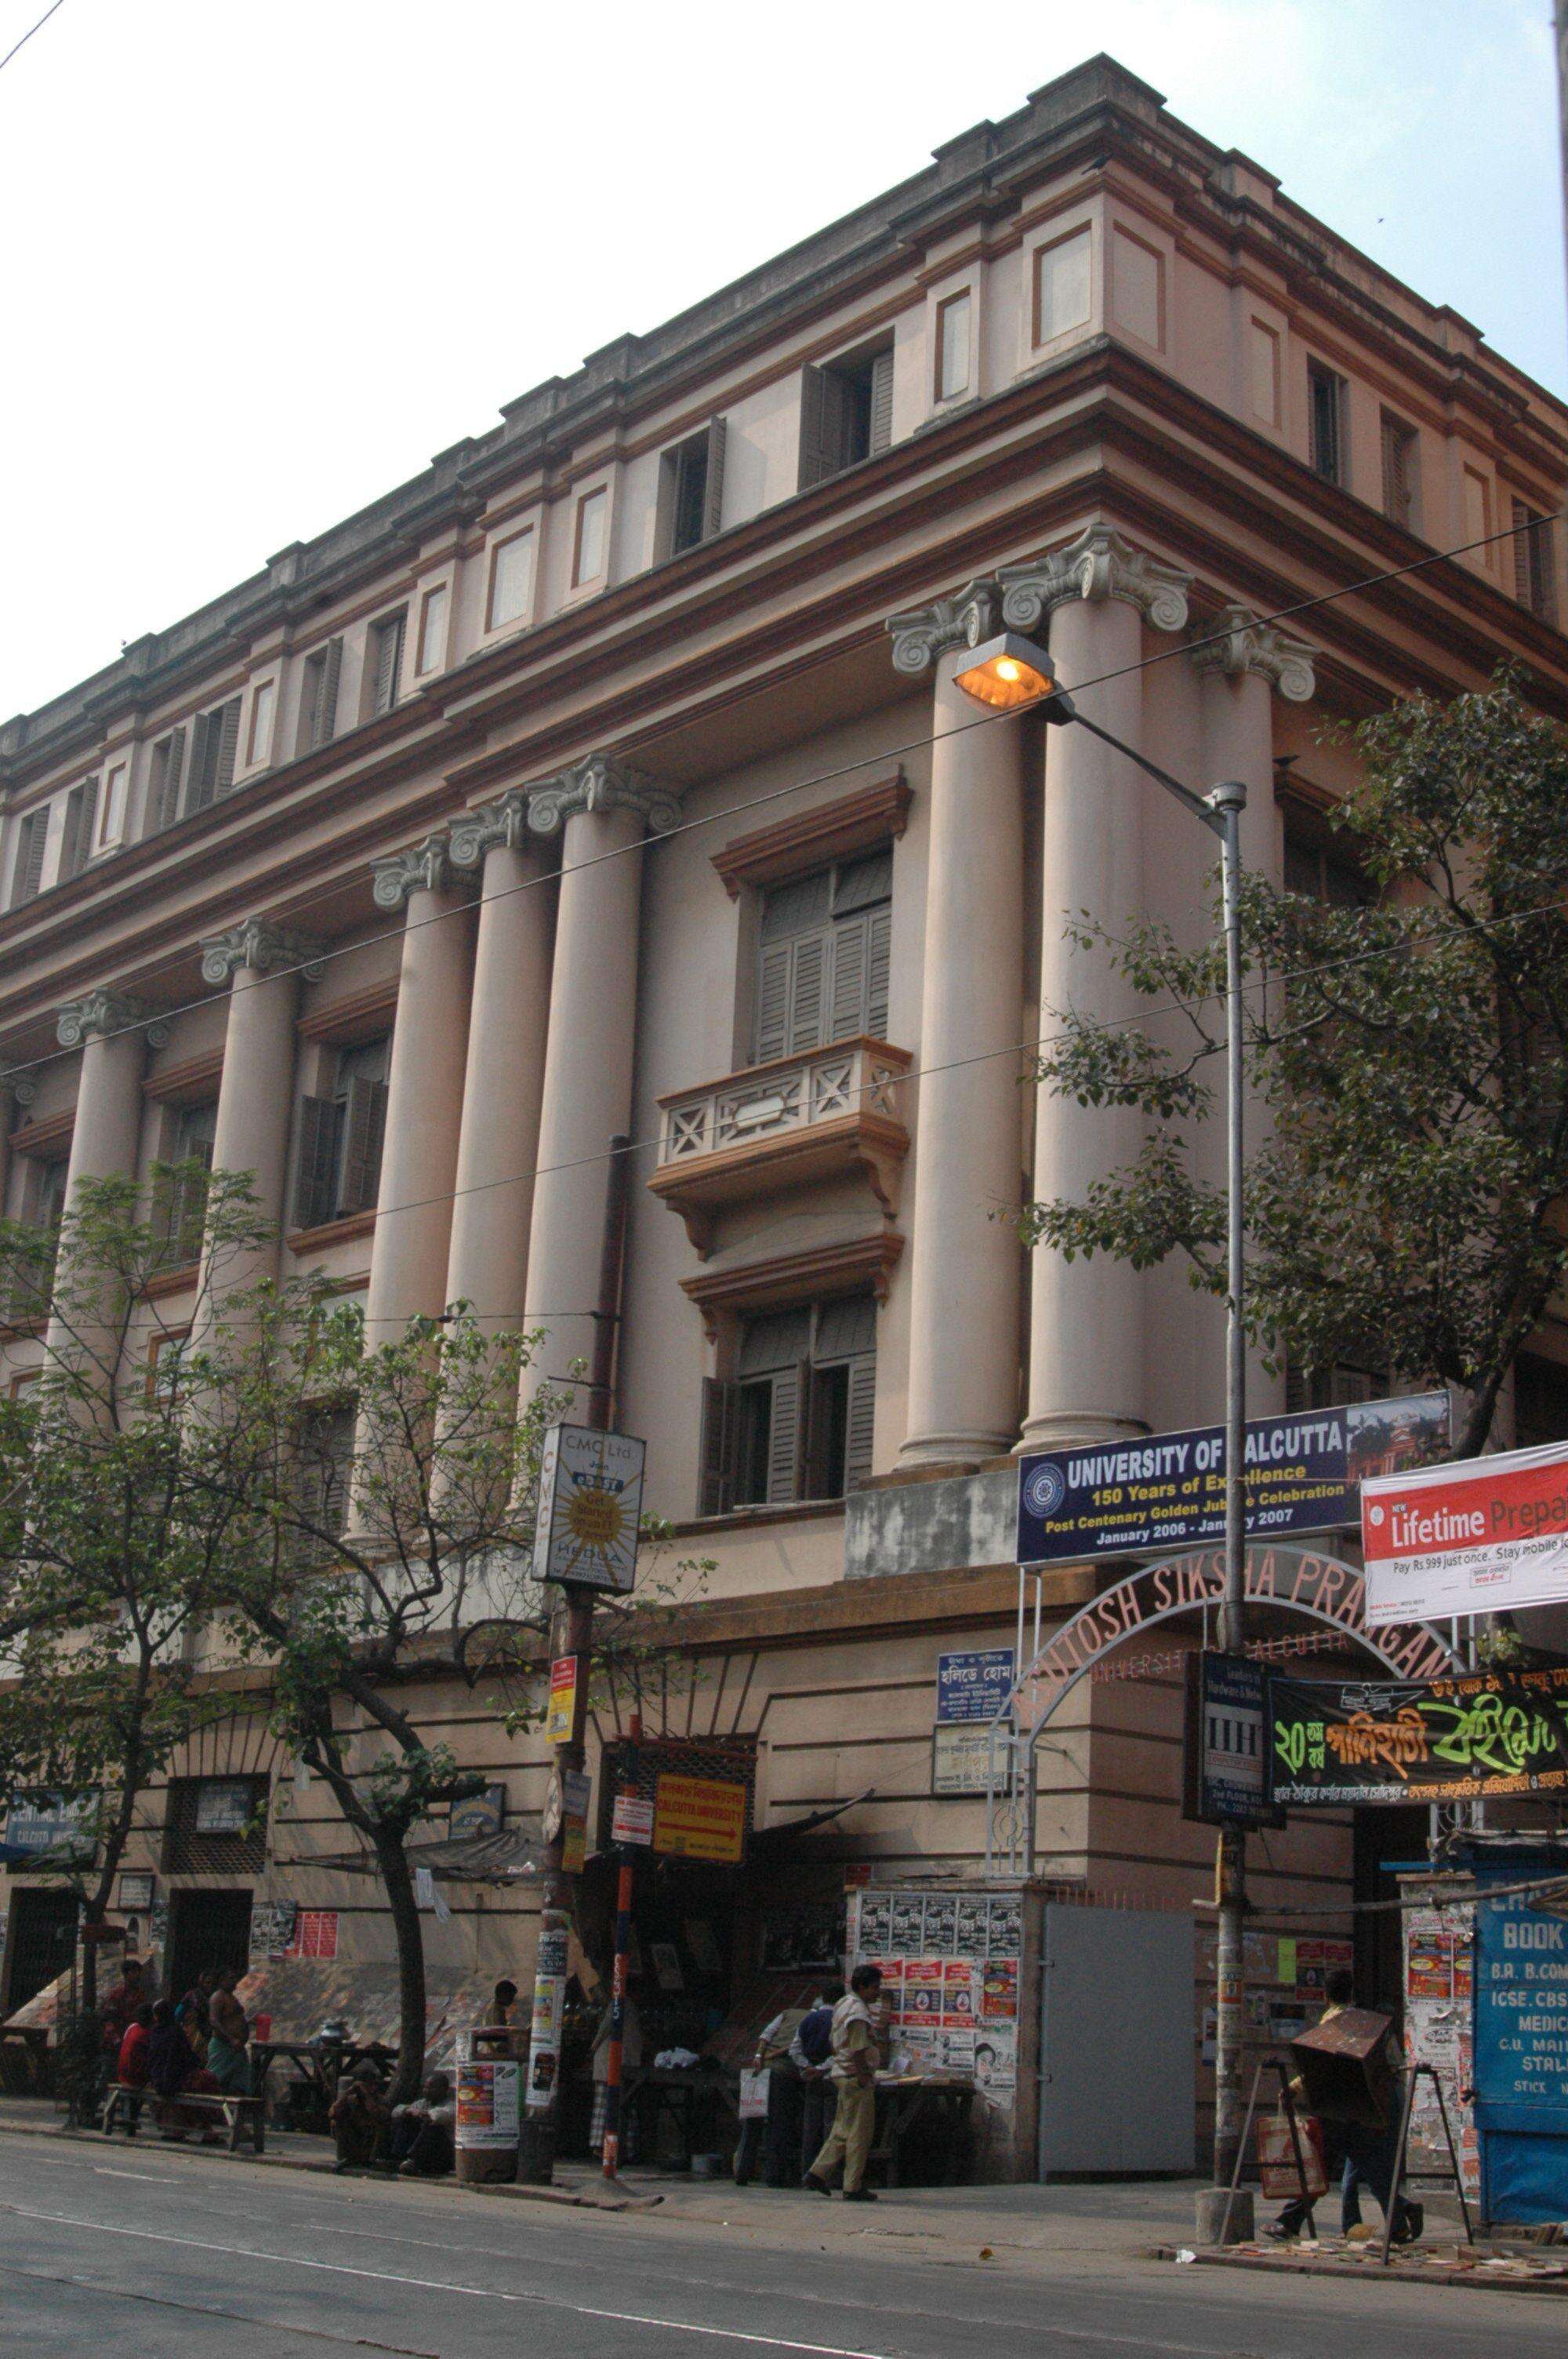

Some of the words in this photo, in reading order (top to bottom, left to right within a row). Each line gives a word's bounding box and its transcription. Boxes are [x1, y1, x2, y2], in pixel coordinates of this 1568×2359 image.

[1068, 1444, 1190, 1488] UNIVERSITY
[1195, 1438, 1223, 1471] OF
[1244, 1421, 1343, 1463] ALCUTTA
[1092, 1488, 1122, 1506] 150
[1127, 1483, 1175, 1502] Years
[1181, 1477, 1200, 1494] of
[1206, 1465, 1307, 1491] Exllence
[1046, 1520, 1074, 1533] Post
[1078, 1511, 1146, 1529] Centenary
[1150, 1503, 1199, 1520] Golden
[1203, 1496, 1254, 1514] Jube
[1259, 1484, 1345, 1506] Celebration
[1096, 1530, 1150, 1545] January
[1153, 1522, 1186, 1539] 2006
[1199, 1516, 1254, 1532] Jany
[1258, 1508, 1294, 1525] 2007
[1392, 1507, 1486, 1548] Lifetime
[1490, 1494, 1568, 1536] Prepa
[1393, 1561, 1410, 1575] Pay
[1443, 1554, 1462, 1570] just
[1496, 1547, 1521, 1561] Stay
[1523, 1539, 1558, 1555] mobile
[941, 1665, 978, 1686] হলিডে
[983, 1665, 1011, 1683] হোম
[1088, 1648, 1185, 1685] UNIVERSIT
[1504, 1923, 1564, 1950] BOOK
[1522, 2056, 1568, 2072] STAL
